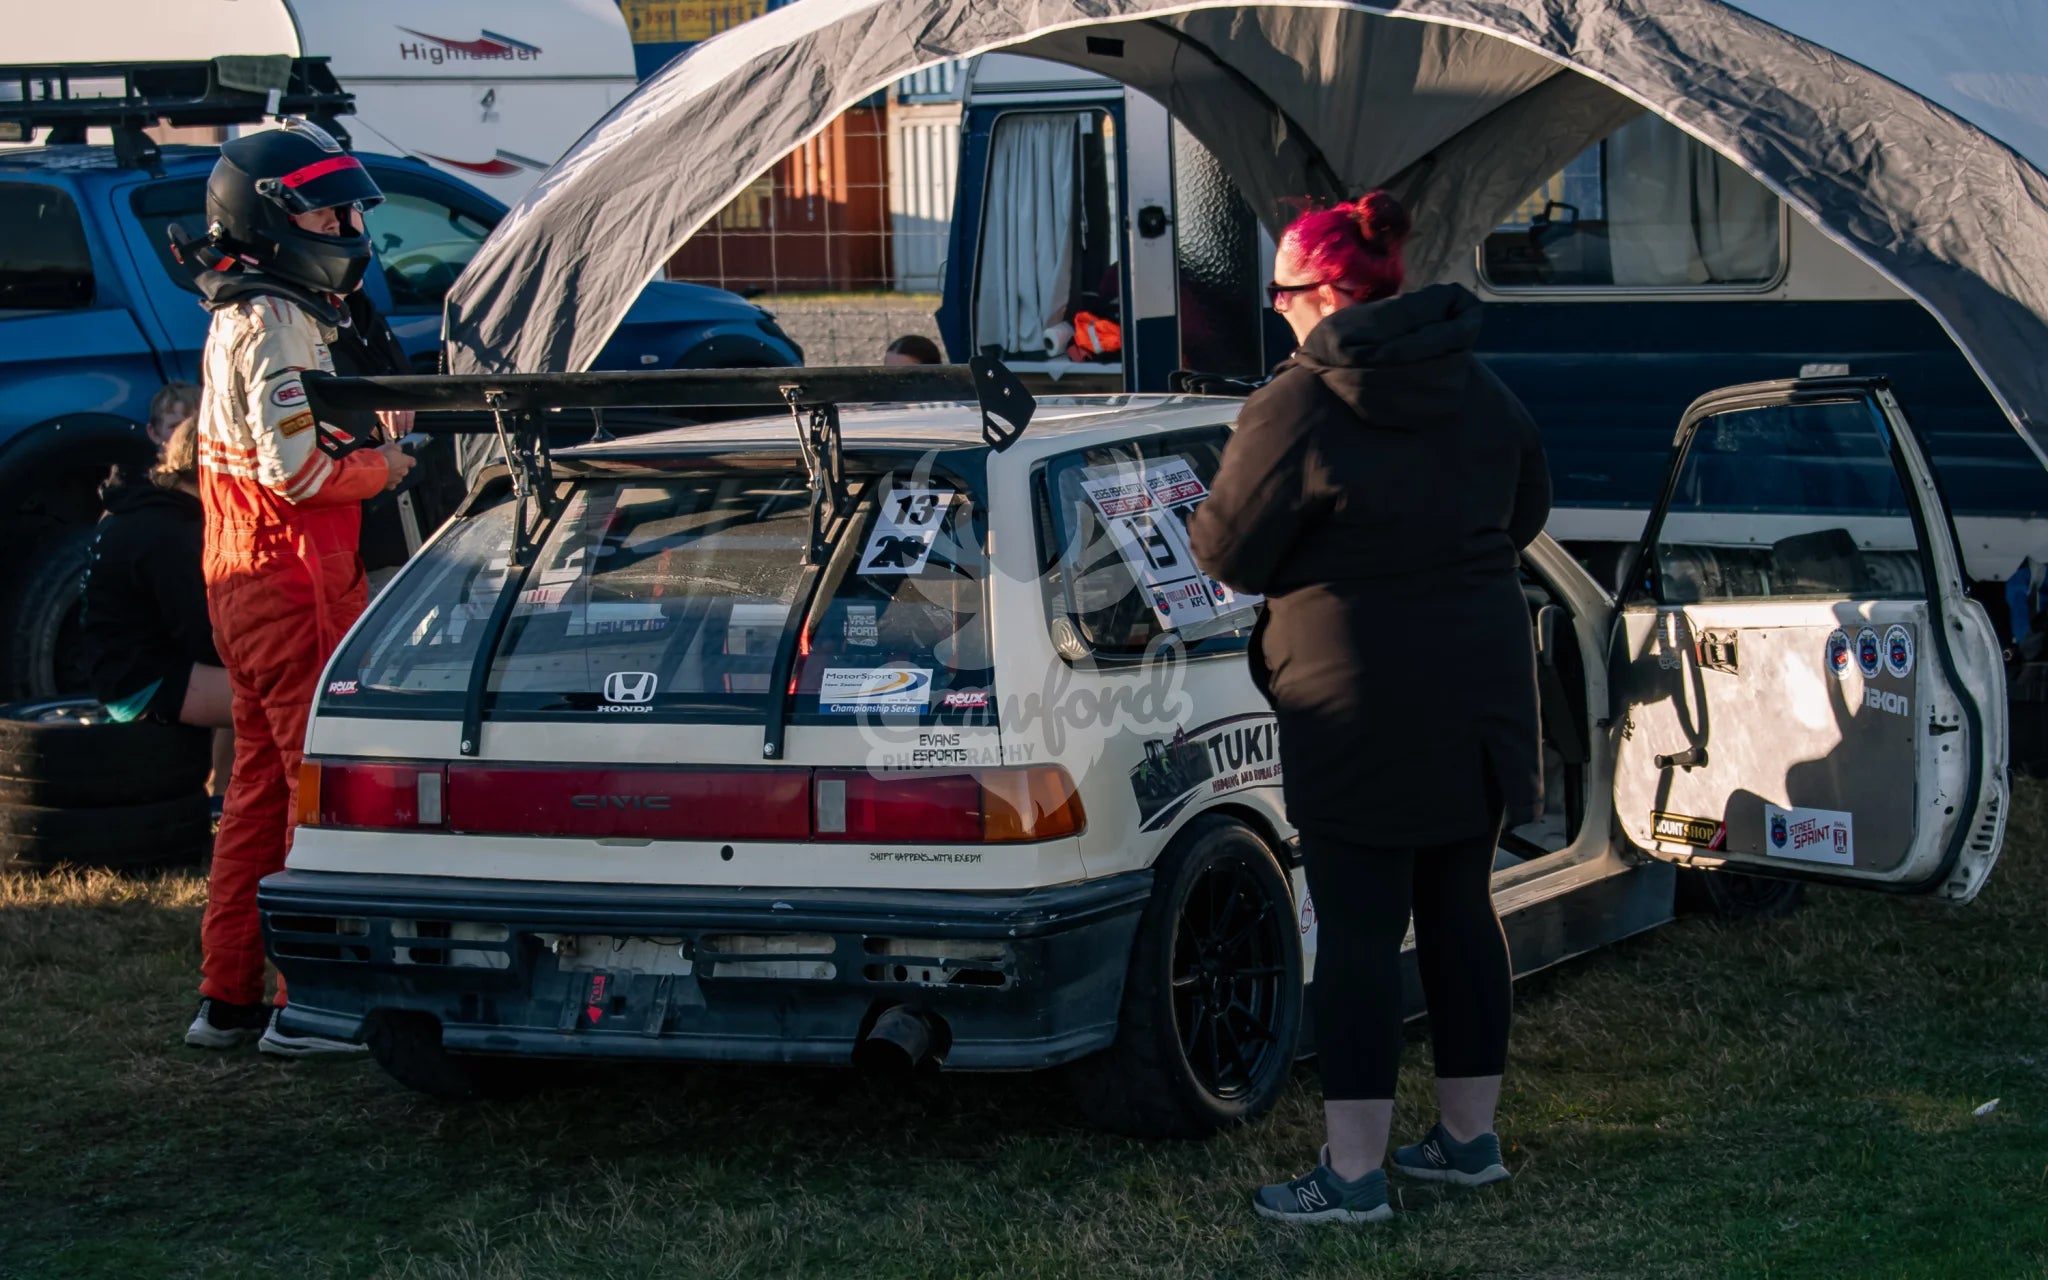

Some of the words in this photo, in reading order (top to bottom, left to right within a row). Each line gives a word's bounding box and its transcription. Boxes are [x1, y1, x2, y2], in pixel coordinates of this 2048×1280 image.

[897, 494, 939, 526] 13
[1190, 595, 1206, 608] KFC
[826, 672, 892, 681] MotorSport
[328, 681, 358, 693] ROUX
[944, 692, 987, 705] ROUX
[597, 705, 654, 713] HONDA
[830, 704, 889, 714] Championship
[891, 704, 916, 713] Series
[919, 733, 960, 748] EVANS
[913, 749, 968, 763] ESPORTS
[571, 794, 671, 810] CIVIC
[1789, 818, 1816, 836] STREET
[1794, 824, 1830, 849] SPRINT
